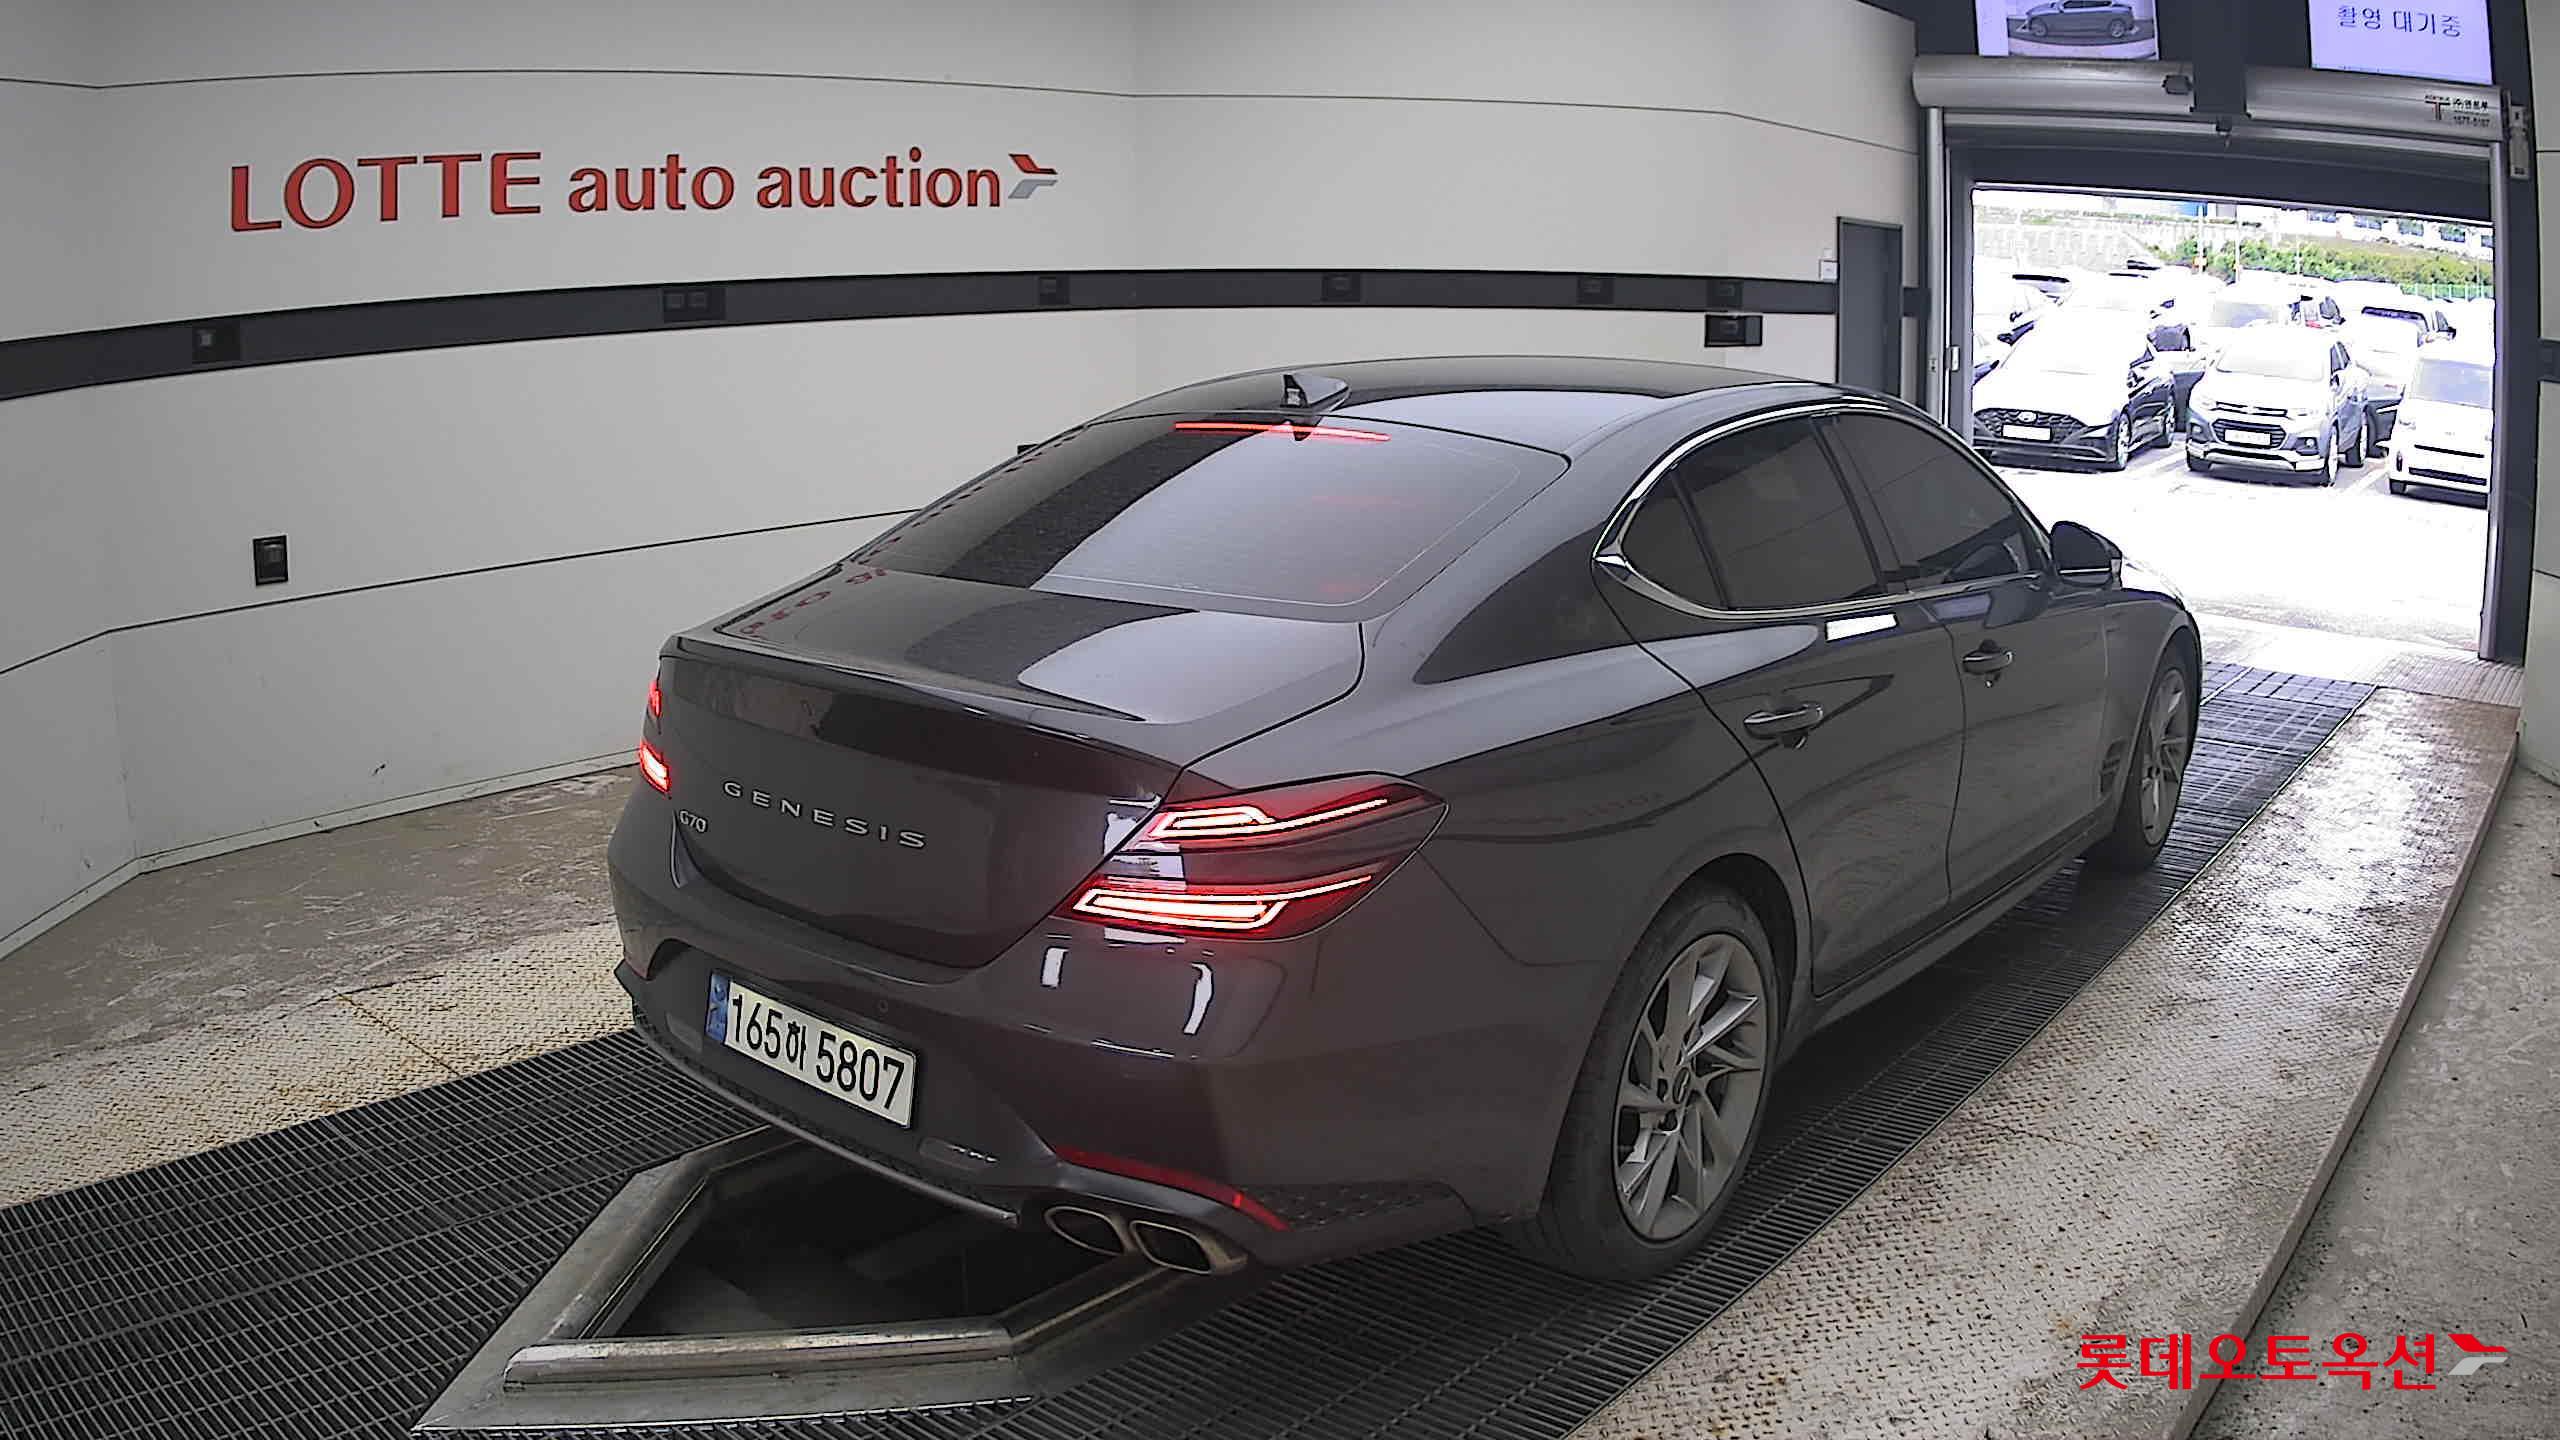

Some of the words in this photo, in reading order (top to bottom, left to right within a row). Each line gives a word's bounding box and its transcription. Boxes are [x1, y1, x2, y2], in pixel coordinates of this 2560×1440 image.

[2338, 5, 2381, 30] 촬영
[2392, 10, 2461, 38] 대기중
[230, 151, 542, 232] LOTTE
[568, 153, 735, 213] auto
[757, 147, 1002, 209] auction
[679, 809, 707, 834] G70
[723, 781, 927, 850] GENESIS
[815, 1030, 905, 1110] 5807
